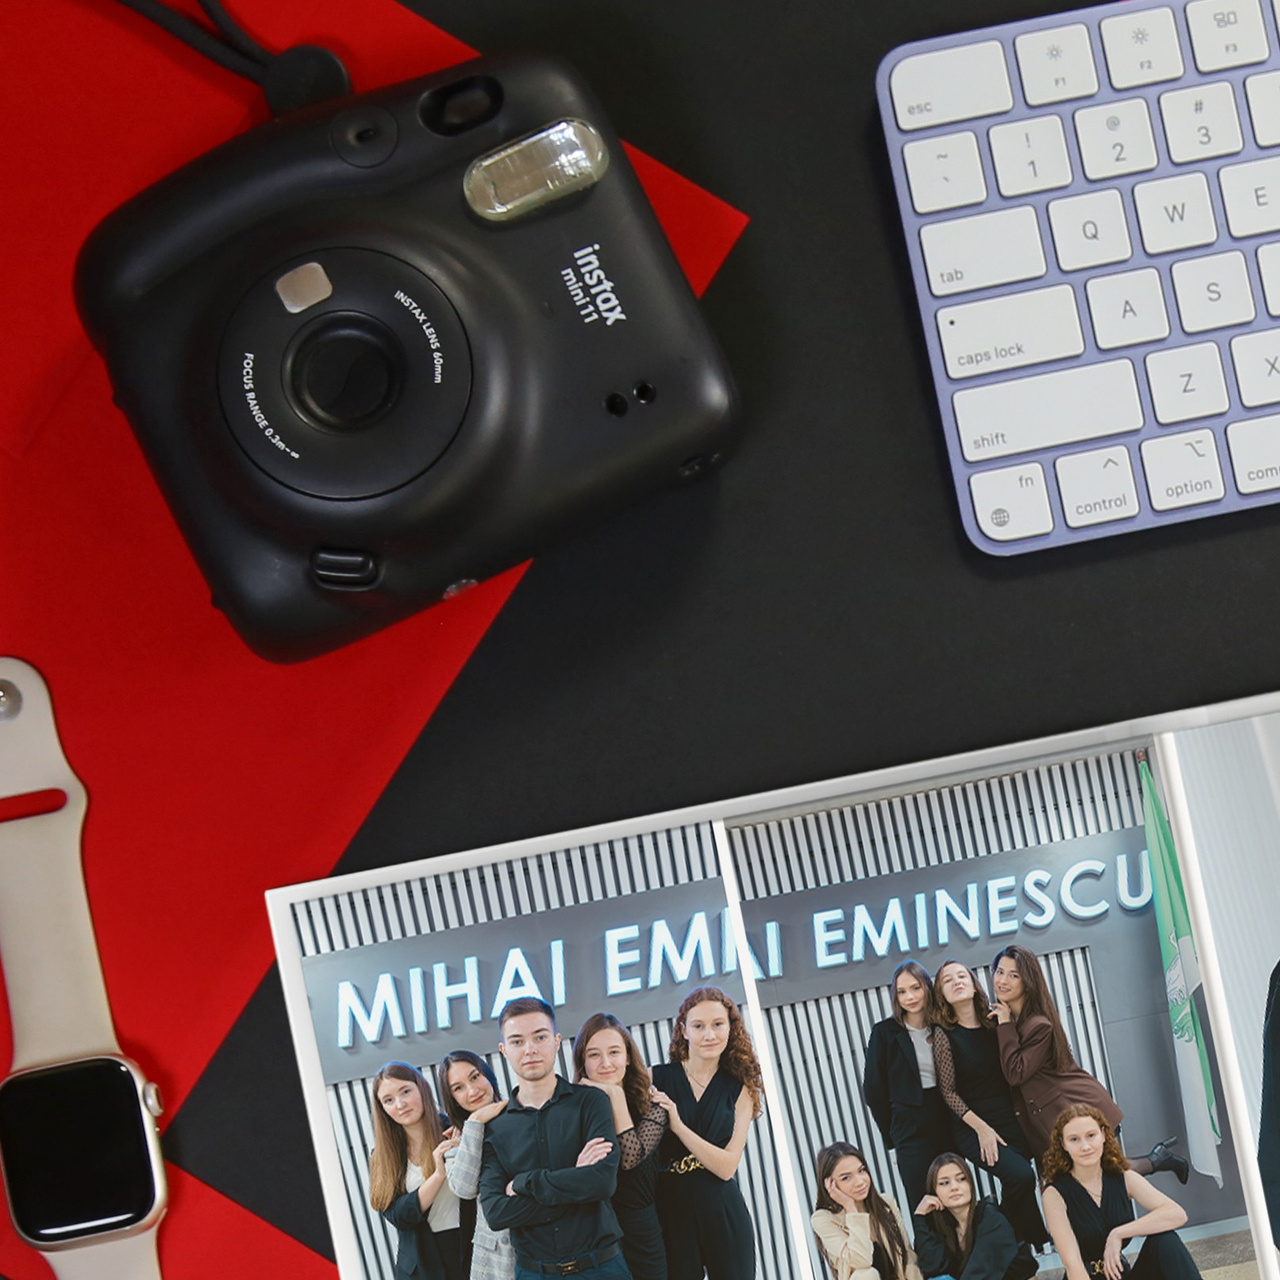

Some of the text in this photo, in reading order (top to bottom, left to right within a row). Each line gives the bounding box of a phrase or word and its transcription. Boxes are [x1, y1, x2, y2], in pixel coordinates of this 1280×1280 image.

[1224, 43, 1238, 54] F3
[1139, 59, 1153, 70] F2
[1054, 76, 1066, 87] F1
[907, 101, 933, 116] esc
[1194, 99, 1204, 114] #
[1105, 115, 1121, 132] @
[1196, 125, 1212, 146] 3
[1111, 142, 1127, 163] 2
[1027, 159, 1038, 178] 1
[1253, 185, 1269, 207] E
[1163, 202, 1186, 224] W
[1081, 220, 1099, 241] Q
[573, 243, 627, 326] instax
[939, 268, 965, 284] tab
[1206, 281, 1222, 303] S
[1121, 299, 1138, 320] A
[394, 290, 443, 383] INSTAX LENS 60mm
[957, 342, 1025, 367] caps lock
[243, 352, 254, 390] FOCUS
[1179, 372, 1196, 394] Z
[245, 391, 269, 429] RANGE
[972, 432, 1007, 450] shift
[1018, 474, 1035, 489] fn
[1165, 477, 1213, 499] option
[1075, 493, 1128, 516] control
[812, 850, 1154, 969] EMINESCU
[337, 939, 566, 1048] MIHAI
